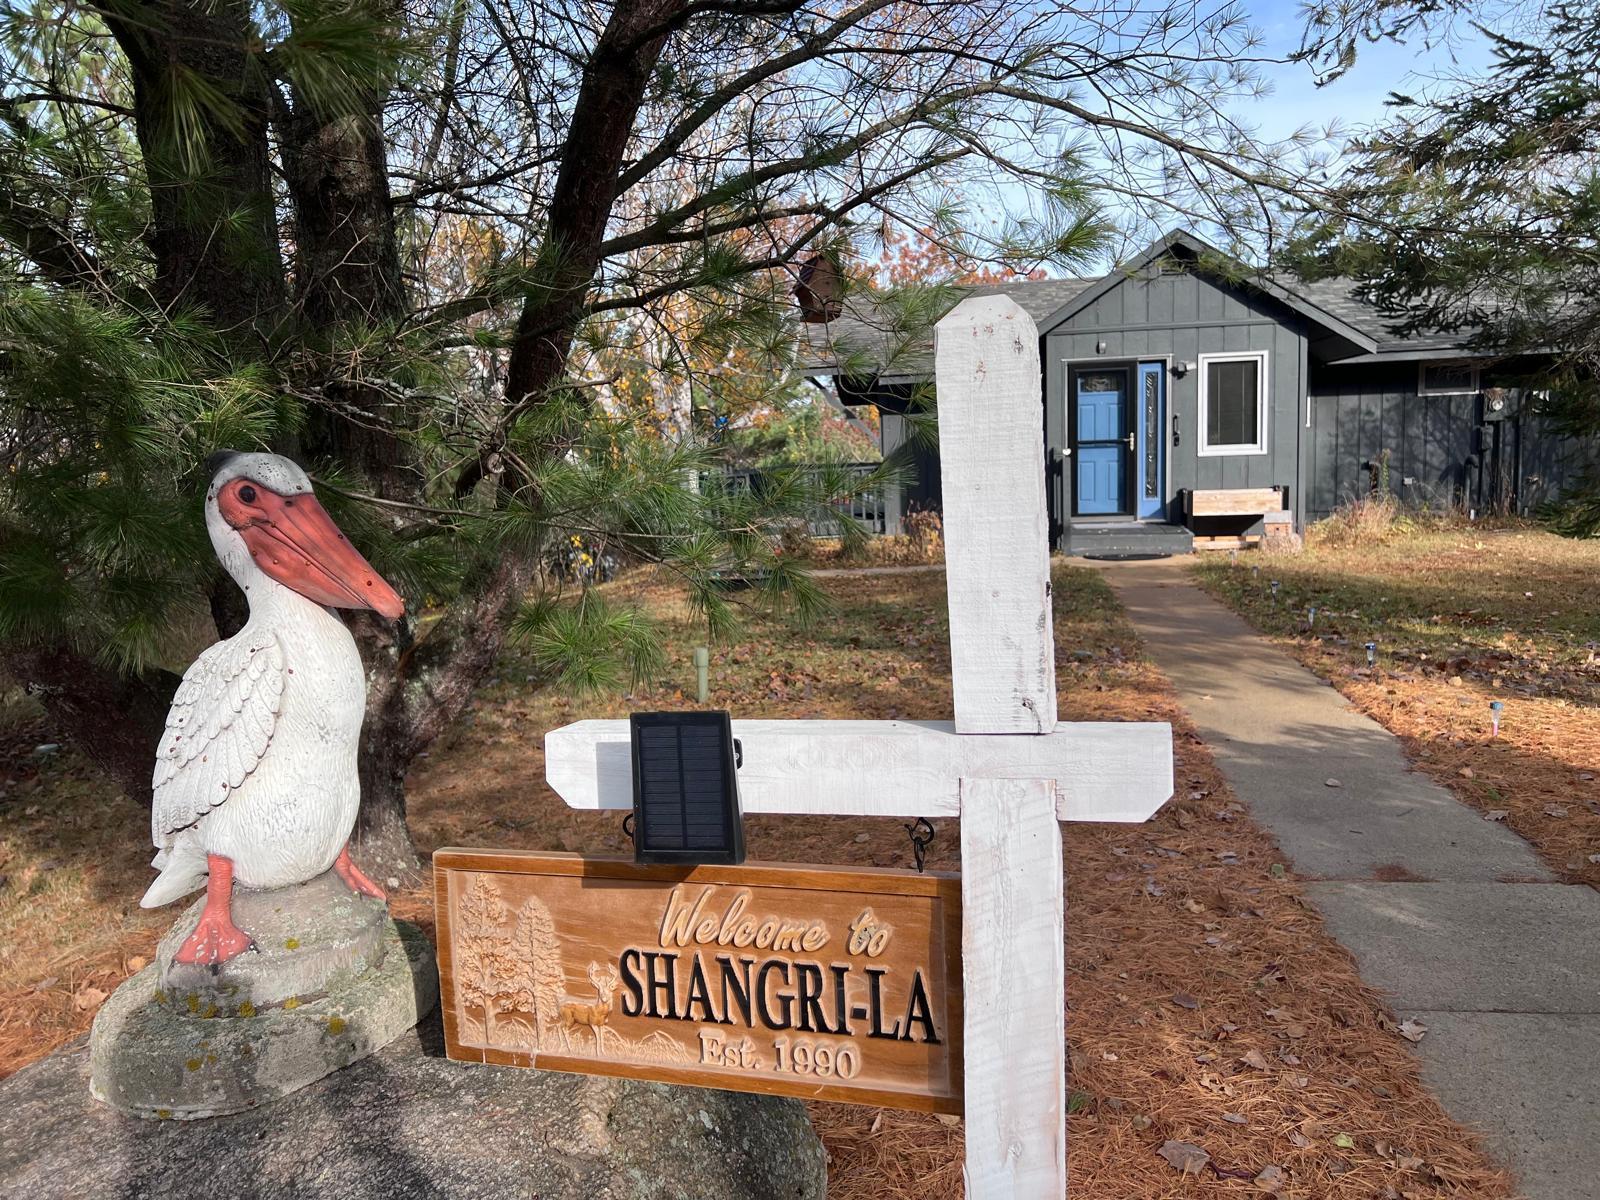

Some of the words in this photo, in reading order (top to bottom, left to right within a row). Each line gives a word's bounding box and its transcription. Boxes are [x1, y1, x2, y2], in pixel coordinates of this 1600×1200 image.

[659, 884, 830, 952] Welcome
[847, 908, 892, 957] to
[619, 949, 942, 1044] SHANGRI-LA
[699, 1030, 760, 1070] Est.
[774, 1038, 859, 1079] 1990
